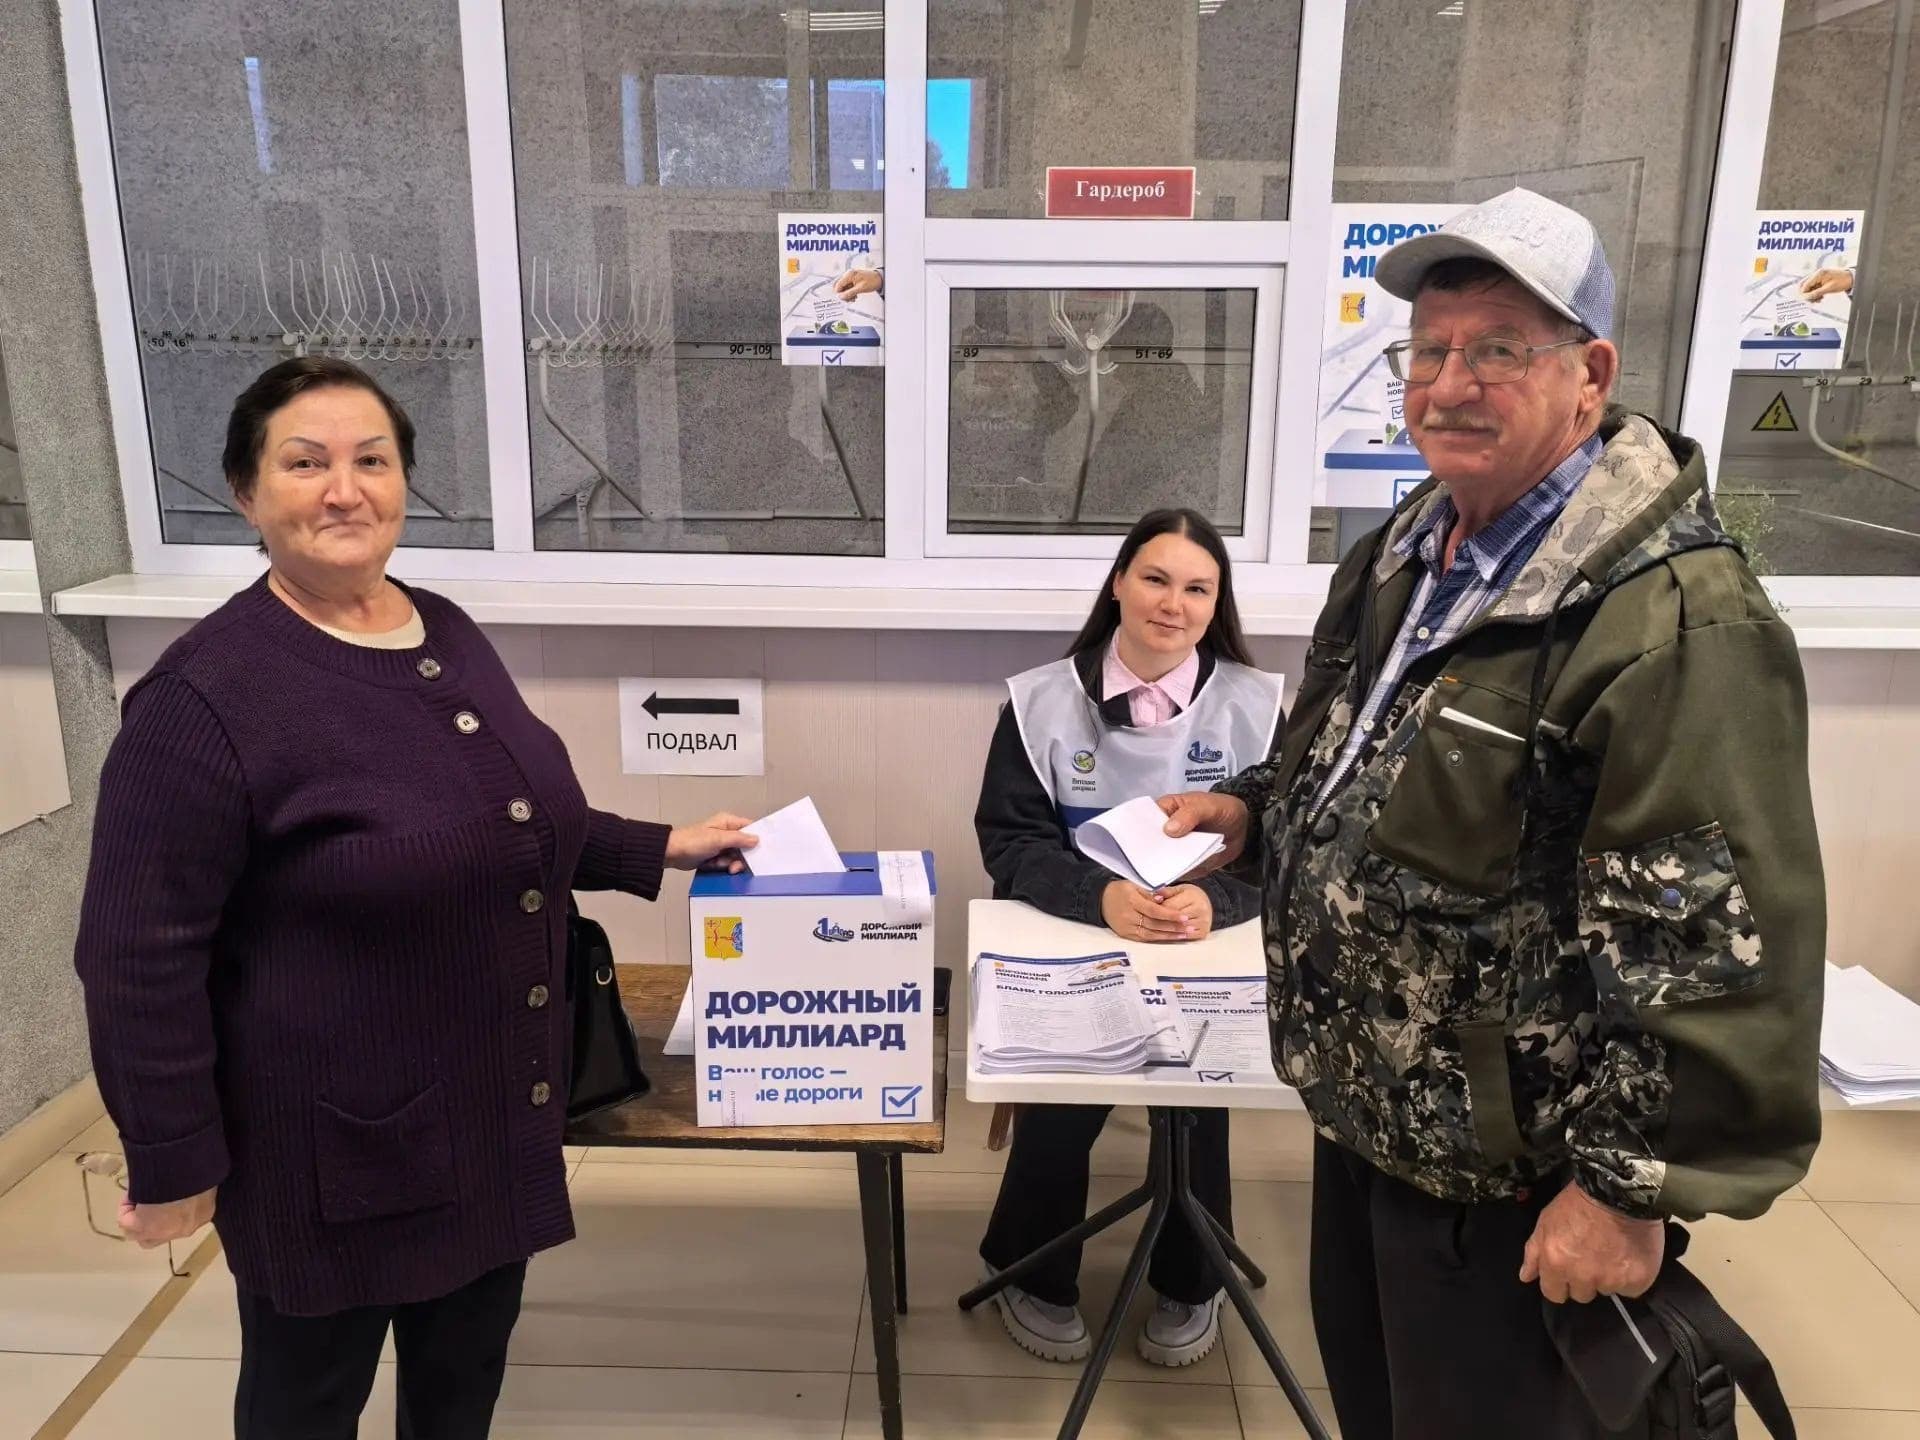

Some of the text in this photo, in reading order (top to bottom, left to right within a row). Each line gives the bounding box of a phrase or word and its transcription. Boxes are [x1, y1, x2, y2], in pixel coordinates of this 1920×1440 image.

[1075, 180, 1165, 202] Гардероб
[786, 220, 876, 237] ДОРОЖНЫЙ
[1759, 218, 1855, 235] ДОРОЖНЫЙ
[786, 239, 870, 253] МИЛЛИАРД
[1757, 237, 1845, 251] МИЛЛИАРД
[729, 344, 773, 360] 90-109
[647, 732, 737, 754] ПОДВАЛ
[1185, 765, 1226, 776] ДОРОЖНЫЙ
[861, 932, 918, 941] МИЛЛИАРД
[996, 984, 1036, 994] БЛАНК
[1039, 981, 1125, 995] ГОЛОСОВАНИЯ
[705, 982, 921, 1019] ДОРОЖНЫЙ
[707, 1023, 906, 1050] МИЛЛИАРД
[761, 1065, 825, 1080] голос
[784, 1086, 863, 1104] дороги
